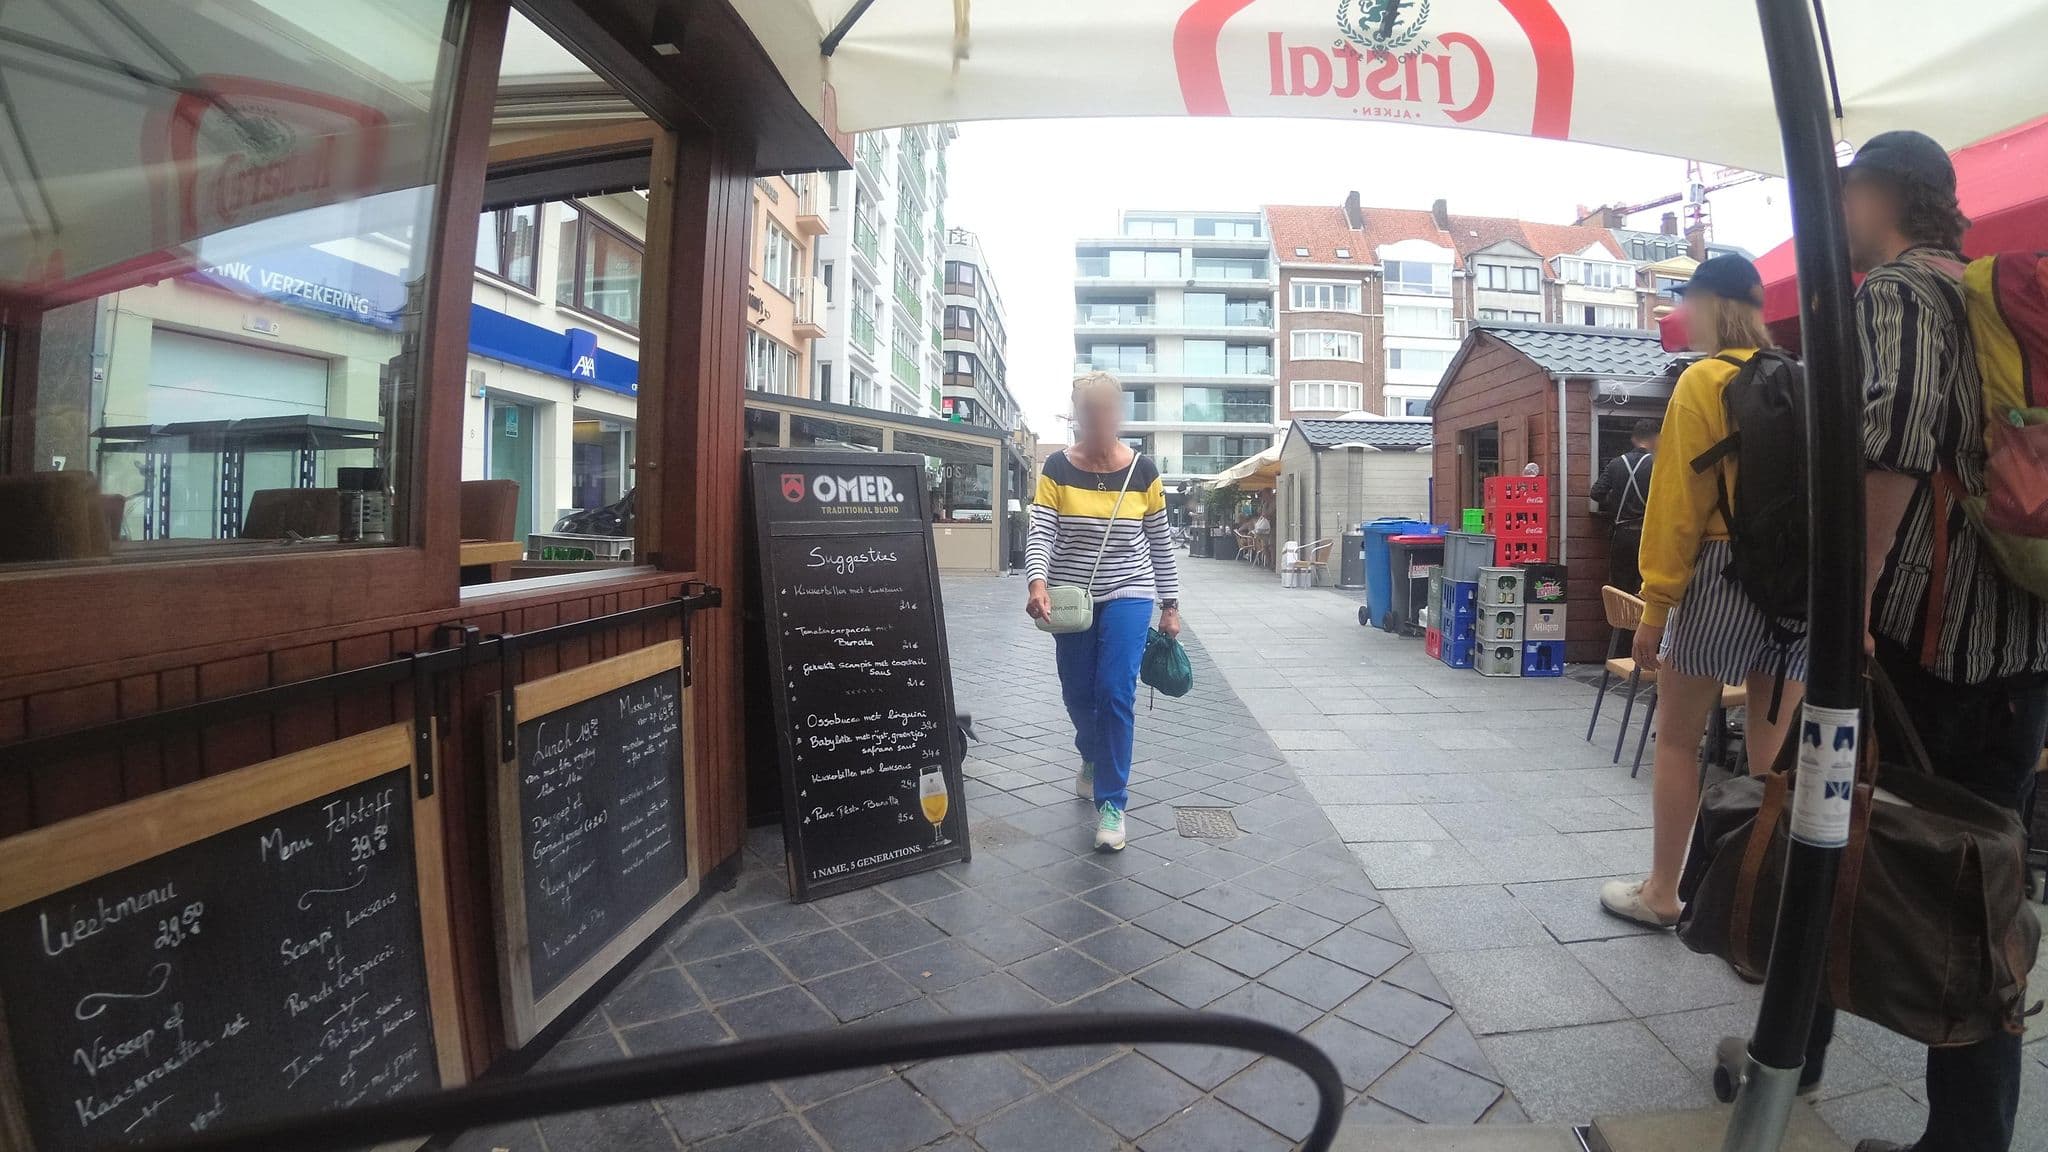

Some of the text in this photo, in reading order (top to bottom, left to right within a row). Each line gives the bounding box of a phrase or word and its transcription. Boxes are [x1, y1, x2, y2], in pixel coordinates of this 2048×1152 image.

[204, 261, 369, 315] ANK VERZEKERING
[572, 355, 596, 379] AXA
[822, 506, 899, 515] TRADITIONAL BLOND
[807, 546, 898, 575] Suggesties
[863, 710, 882, 721] met
[887, 708, 927, 727] linguini
[532, 722, 574, 767] Lunch
[855, 732, 870, 742] met
[260, 788, 393, 863] Menu Falstaff
[812, 871, 817, 879] 1
[818, 863, 850, 878] NAME,
[850, 861, 856, 870] 5
[39, 881, 178, 957] Weekmenu
